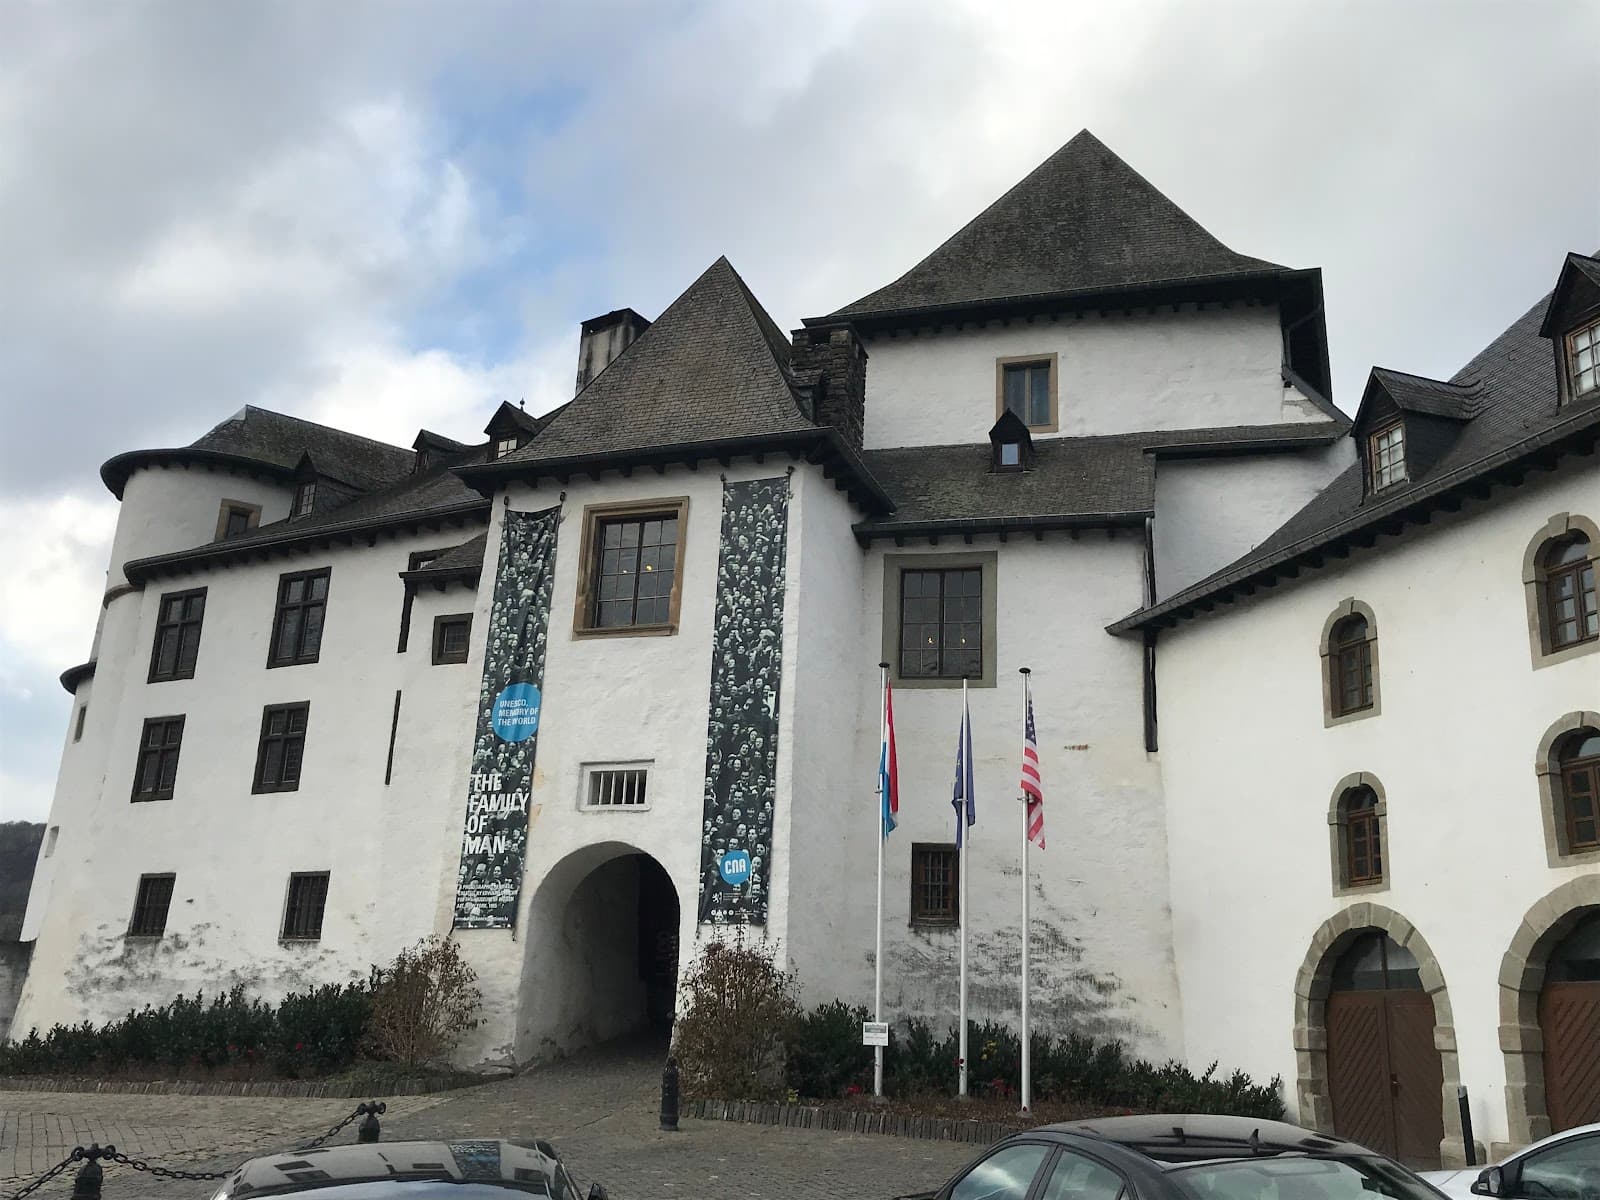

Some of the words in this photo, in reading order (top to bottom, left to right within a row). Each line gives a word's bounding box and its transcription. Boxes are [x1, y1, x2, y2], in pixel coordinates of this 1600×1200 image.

[500, 699, 529, 707] UNESCO,
[498, 707, 530, 717] MEMORY
[530, 707, 539, 715] OF
[498, 718, 511, 726] THE
[512, 717, 536, 725] WORLD
[472, 773, 502, 791] THE
[469, 793, 530, 812] FAMILY
[467, 815, 489, 833] OF
[464, 835, 506, 854] MAN
[725, 859, 746, 874] CNA
